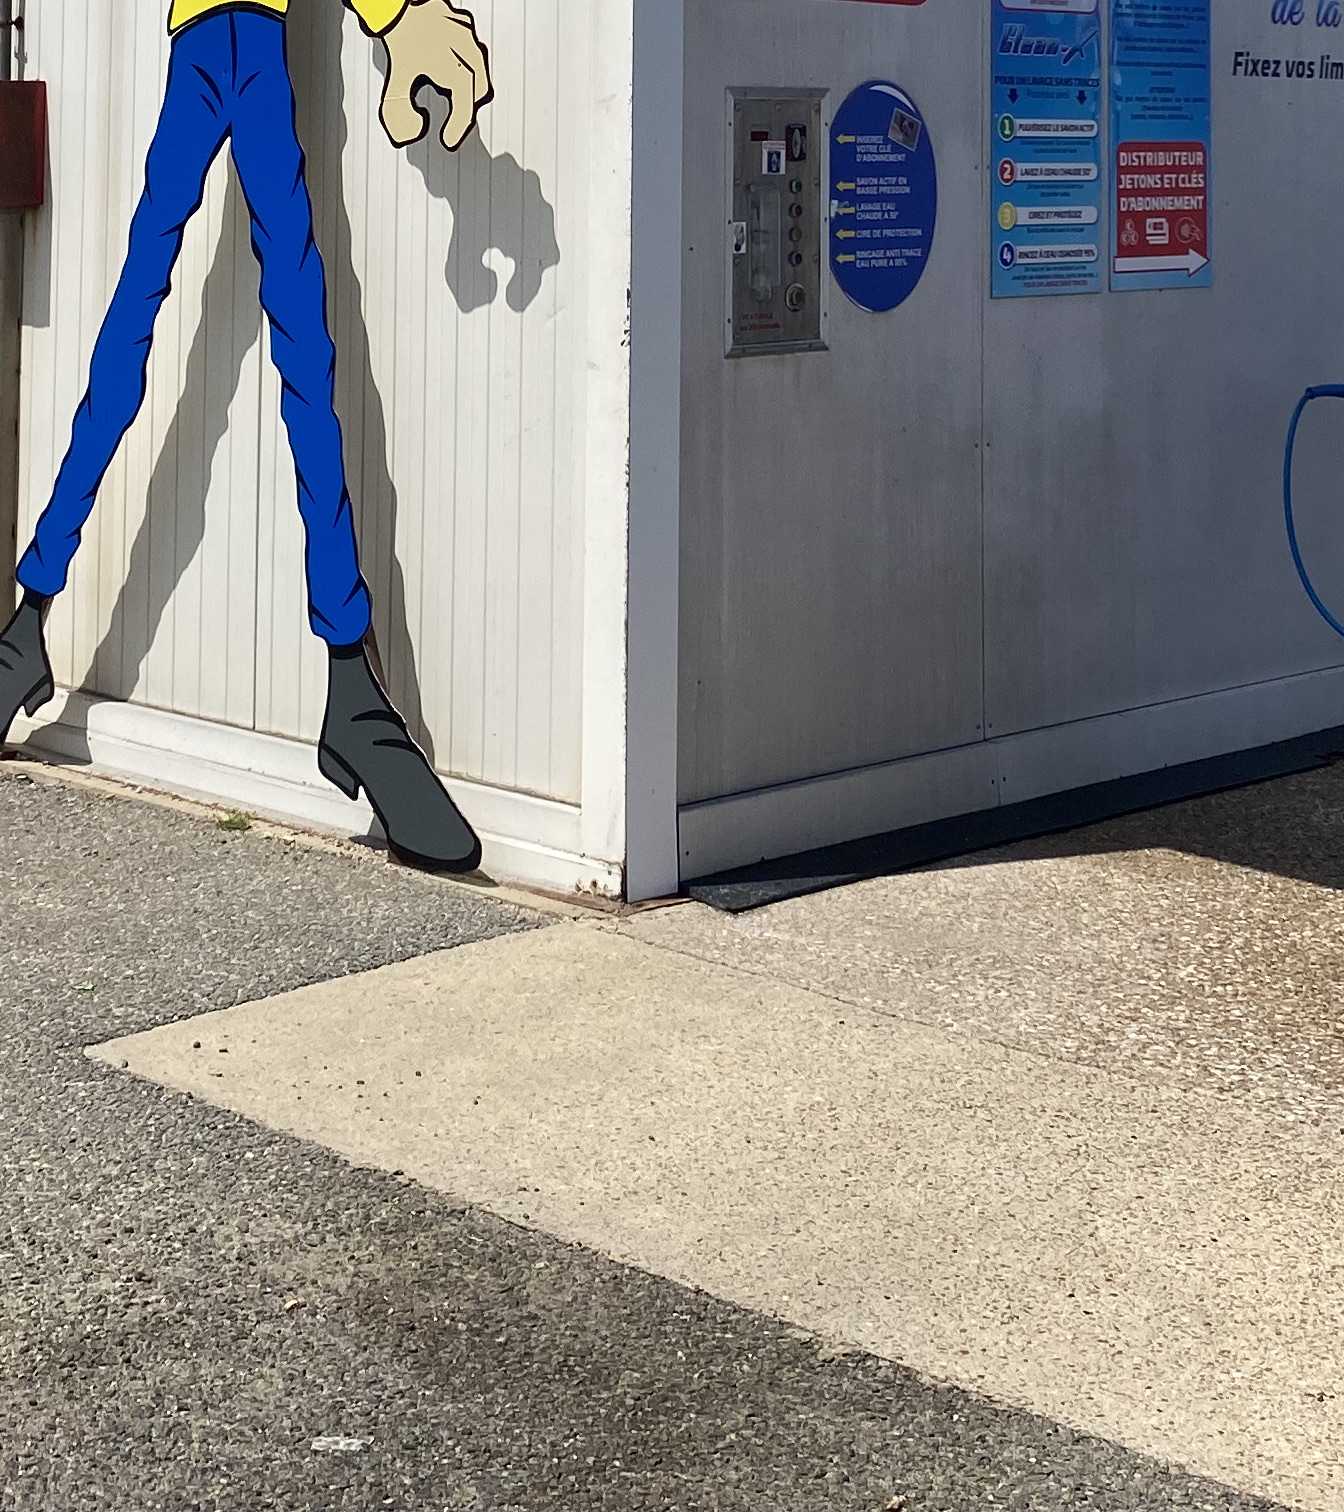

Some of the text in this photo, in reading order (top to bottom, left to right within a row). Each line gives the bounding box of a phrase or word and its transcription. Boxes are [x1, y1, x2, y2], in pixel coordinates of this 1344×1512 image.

[1232, 51, 1281, 78] Fixez
[1285, 59, 1315, 79] vos
[1004, 119, 1011, 135] 1
[1119, 151, 1204, 166] DISTRIBUTEUR
[1003, 164, 1011, 179] 2
[1118, 170, 1204, 189] JETONS ET CLÉS
[1120, 196, 1204, 211] D'ABONNEMENT
[1003, 208, 1011, 224] 3
[1003, 247, 1011, 263] 4
